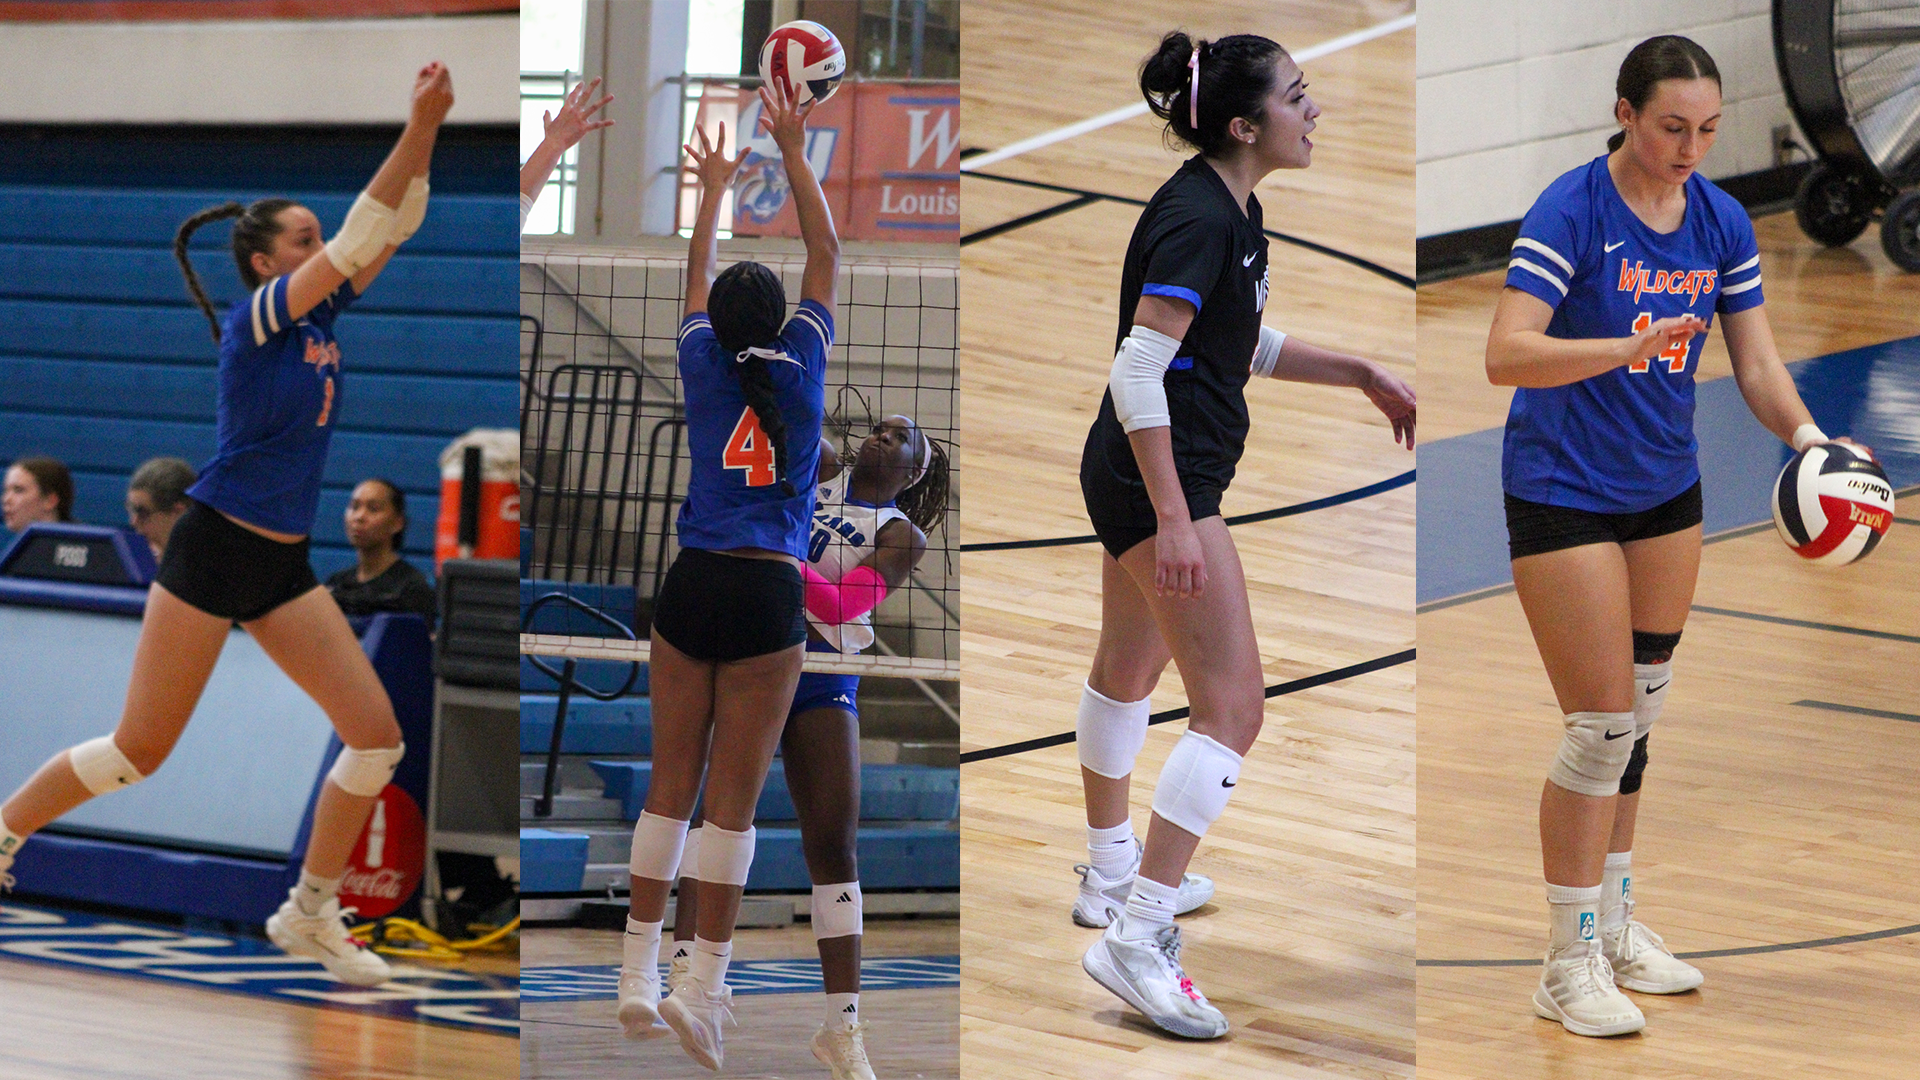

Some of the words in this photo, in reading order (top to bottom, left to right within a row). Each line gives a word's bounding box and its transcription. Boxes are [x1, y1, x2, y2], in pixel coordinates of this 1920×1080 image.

[880, 185, 960, 216] Louis
[1617, 258, 1718, 308] WILDCATS
[1628, 311, 1696, 374] 14
[722, 404, 777, 487] 4
[1846, 479, 1890, 503] Baden
